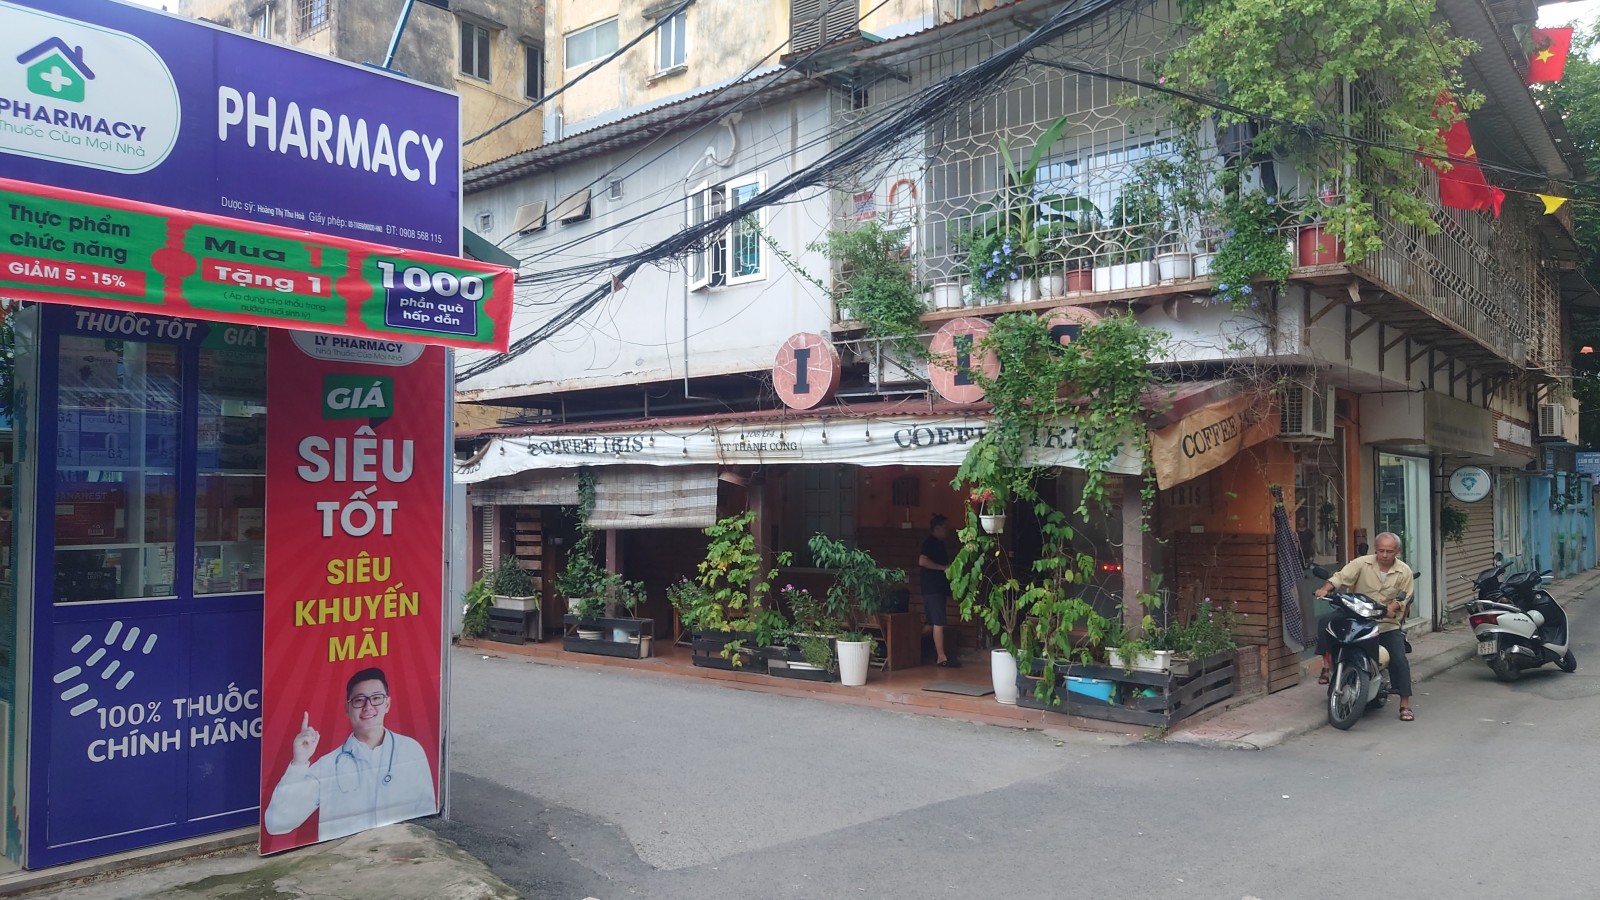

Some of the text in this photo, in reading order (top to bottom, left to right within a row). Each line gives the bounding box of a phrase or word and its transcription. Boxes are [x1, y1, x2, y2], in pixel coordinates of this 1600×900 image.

[0, 97, 147, 142] PHARMACY
[218, 85, 443, 185] PHARMACY
[49, 129, 81, 145] Của
[86, 136, 112, 152] Mọi
[116, 142, 145, 157] Nhà
[8, 204, 130, 237] Thực phẩm
[221, 196, 242, 211] Dược
[308, 211, 326, 224] Giấy
[327, 216, 347, 228] phép:
[386, 224, 398, 237] ĐT:
[399, 227, 416, 239] 0908
[417, 231, 429, 241] 568
[430, 234, 443, 244] 115
[9, 232, 128, 264] chức năng
[204, 236, 322, 268] Mua 1
[8, 260, 60, 279] GIẢM
[65, 268, 76, 281] 5
[92, 271, 126, 287] 15%
[214, 265, 321, 294] Tặng 1
[378, 261, 484, 300] 1000
[400, 297, 464, 314] phần quà
[403, 310, 460, 326] hấp dẫn
[314, 335, 403, 353] LY PHARMACY
[315, 347, 331, 356] Nhà
[326, 380, 386, 410] GIÁ
[297, 425, 414, 483] SIÊU
[529, 436, 645, 457] COFFEE IRIS
[1182, 415, 1238, 459] COFFEE
[316, 484, 398, 537] TỐT
[326, 550, 391, 585] SIÊU
[295, 581, 419, 627] KHUYẾN
[328, 627, 388, 662] MÃI
[97, 681, 259, 730] 100% THUỐC
[87, 716, 262, 763] CHÍNH HÃNG
